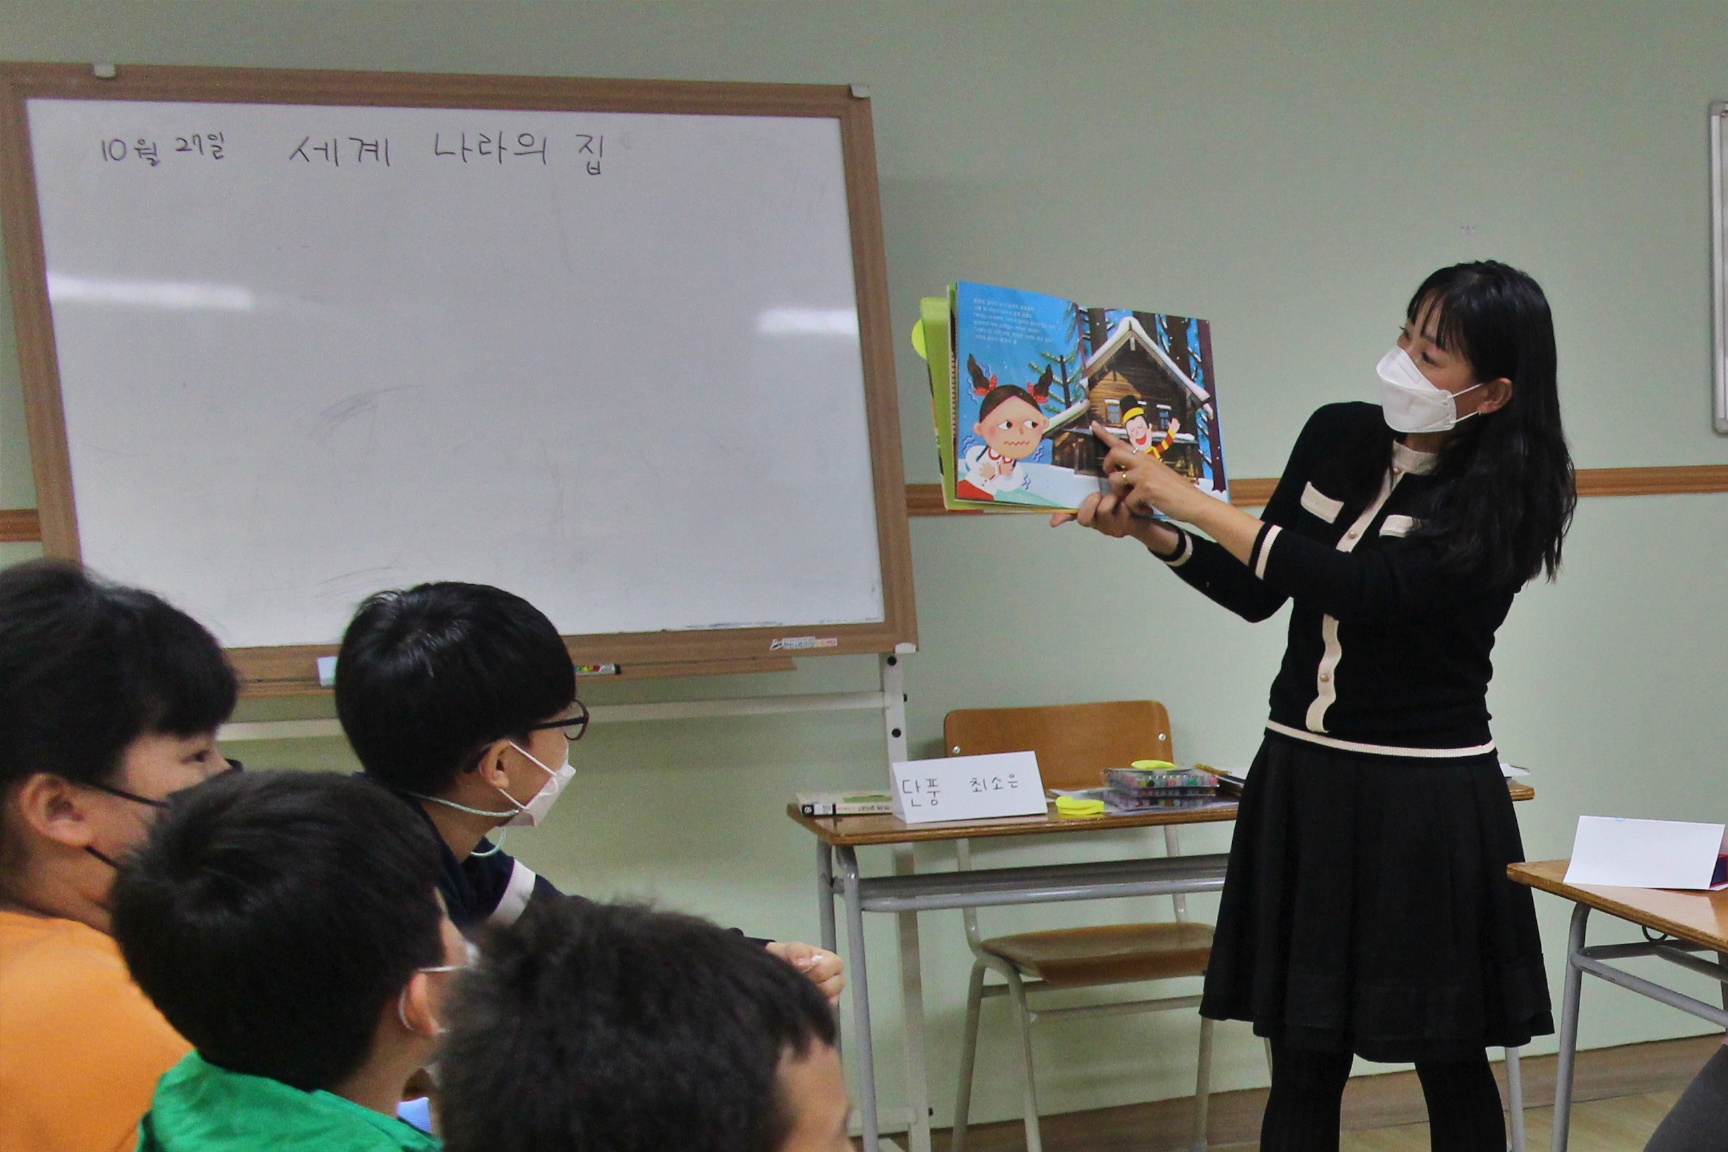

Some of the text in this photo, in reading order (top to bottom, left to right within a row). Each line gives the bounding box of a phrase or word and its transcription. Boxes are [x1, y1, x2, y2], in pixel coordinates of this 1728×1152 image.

[100, 131, 603, 176] 10월 27일 세계 나라의 집
[902, 773, 1020, 807] 단풍 최소은
